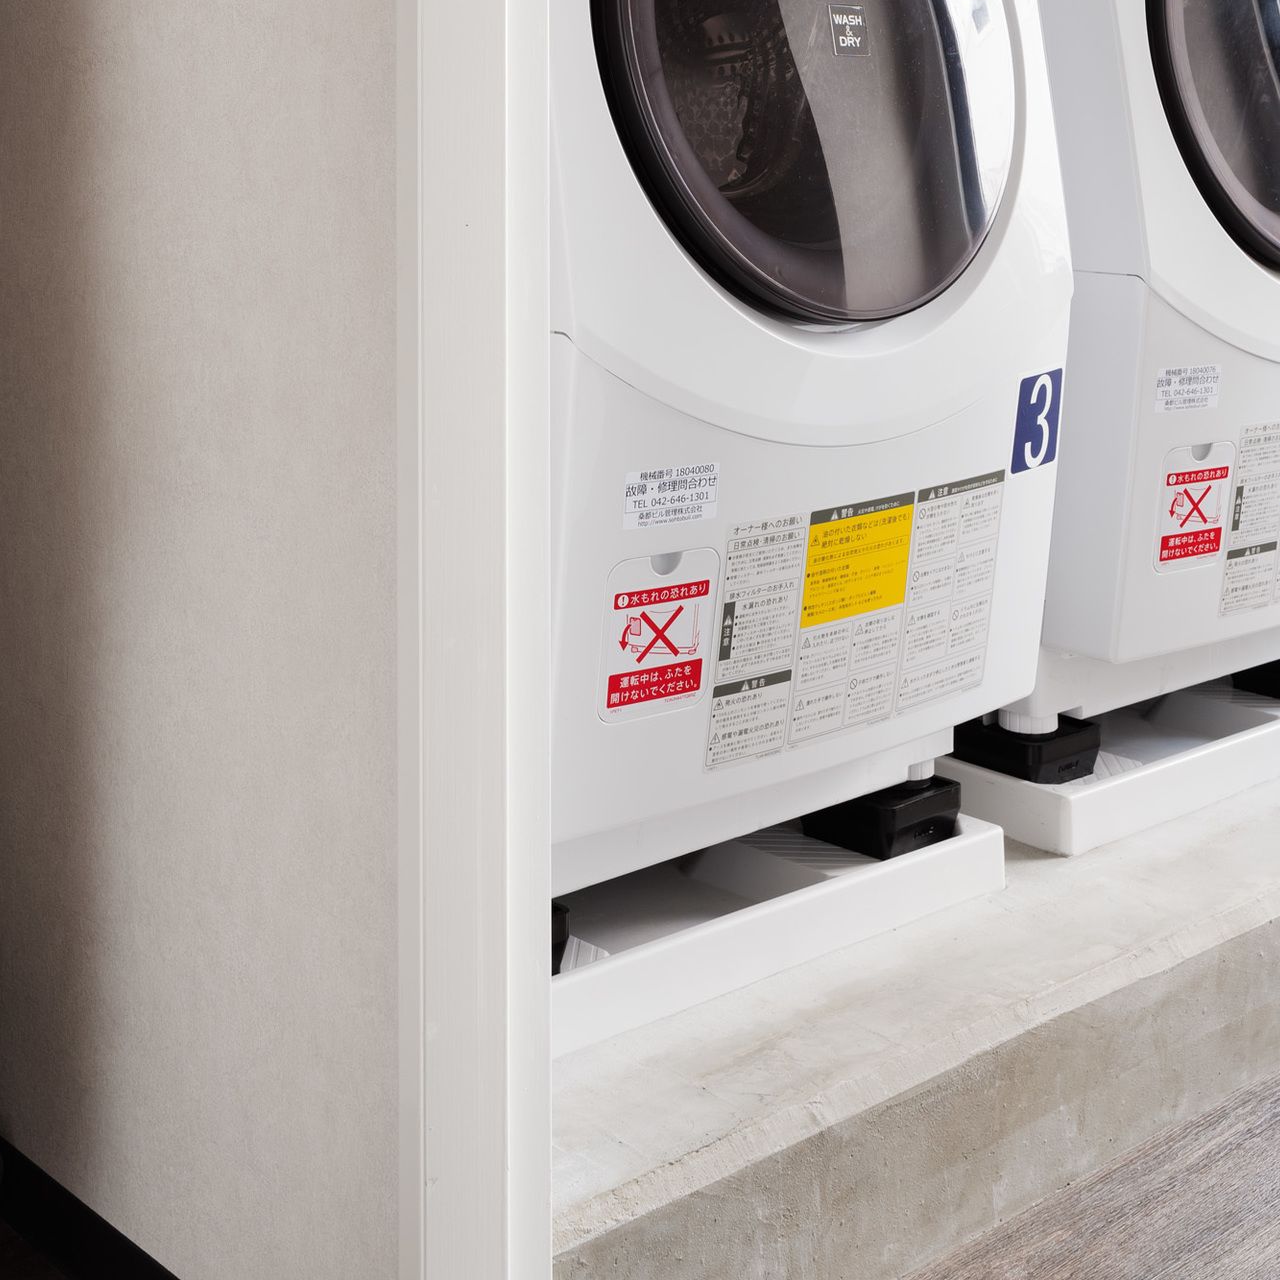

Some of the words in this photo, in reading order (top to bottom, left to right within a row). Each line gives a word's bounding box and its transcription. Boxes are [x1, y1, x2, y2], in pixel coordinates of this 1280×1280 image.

[832, 14, 862, 26] WASH
[845, 25, 853, 36] &
[839, 36, 861, 47] DRY
[1025, 374, 1053, 469] 3
[640, 468, 673, 481] 機械番号
[676, 463, 715, 477] 18040080
[1178, 468, 1227, 483] 水もれの恐れあり
[625, 475, 717, 497] 故障・修理問合わせ
[633, 499, 648, 509] TEL
[651, 491, 709, 507] 042-646-1301
[733, 516, 803, 536] オーナー様へのお願い
[1168, 531, 1215, 547] 運転中は、ふたを
[1161, 542, 1218, 559] 開けないでください。
[630, 583, 706, 605] 水もれの恐れあり
[620, 665, 692, 689] 運転中は、ふたを
[609, 679, 697, 705] 開けないでください。
